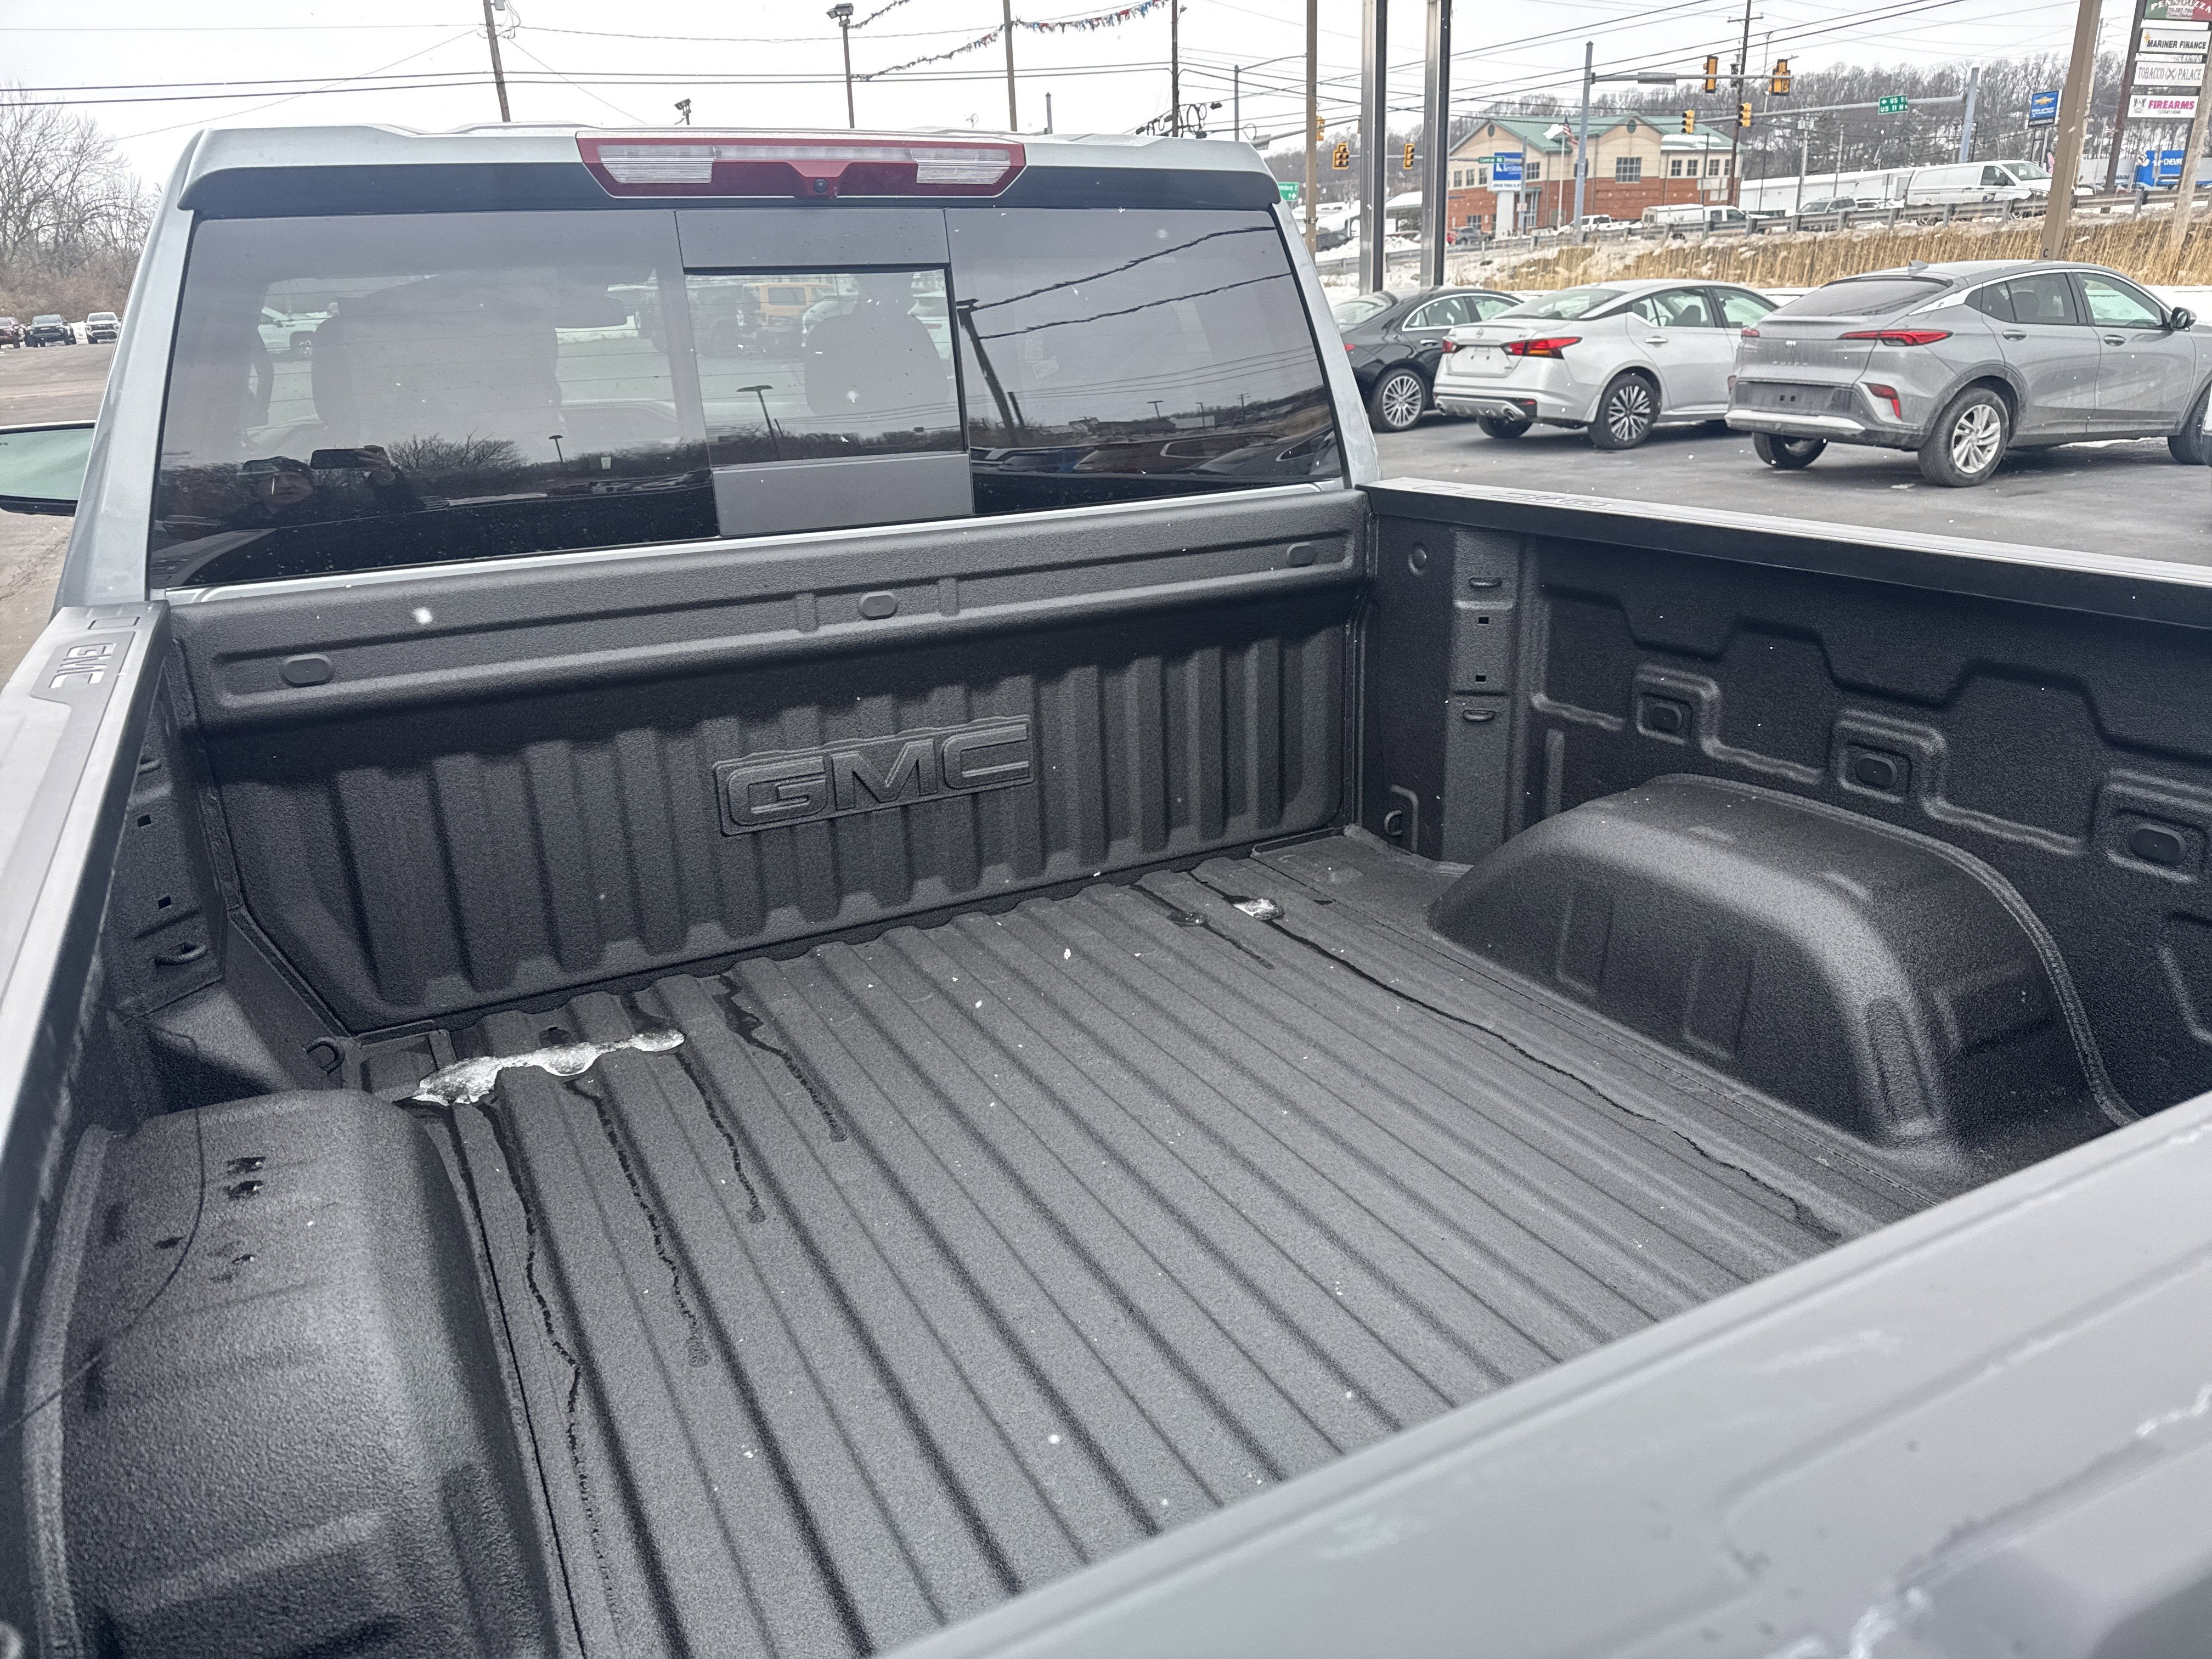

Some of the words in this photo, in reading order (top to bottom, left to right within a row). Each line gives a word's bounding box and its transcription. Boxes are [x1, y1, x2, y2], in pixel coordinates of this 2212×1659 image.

[2151, 0, 2179, 11] PENN
[2182, 0, 2212, 13] PIZZA
[2147, 40, 2177, 48] MARINER
[2179, 41, 2207, 49] FINANCE
[2138, 67, 2165, 80] TOBACCO
[2177, 68, 2202, 80] PALACE
[2148, 100, 2195, 110] FIREARMS
[2043, 248, 2049, 258] C
[48, 642, 117, 689] GMC
[726, 723, 1031, 827] GMC
